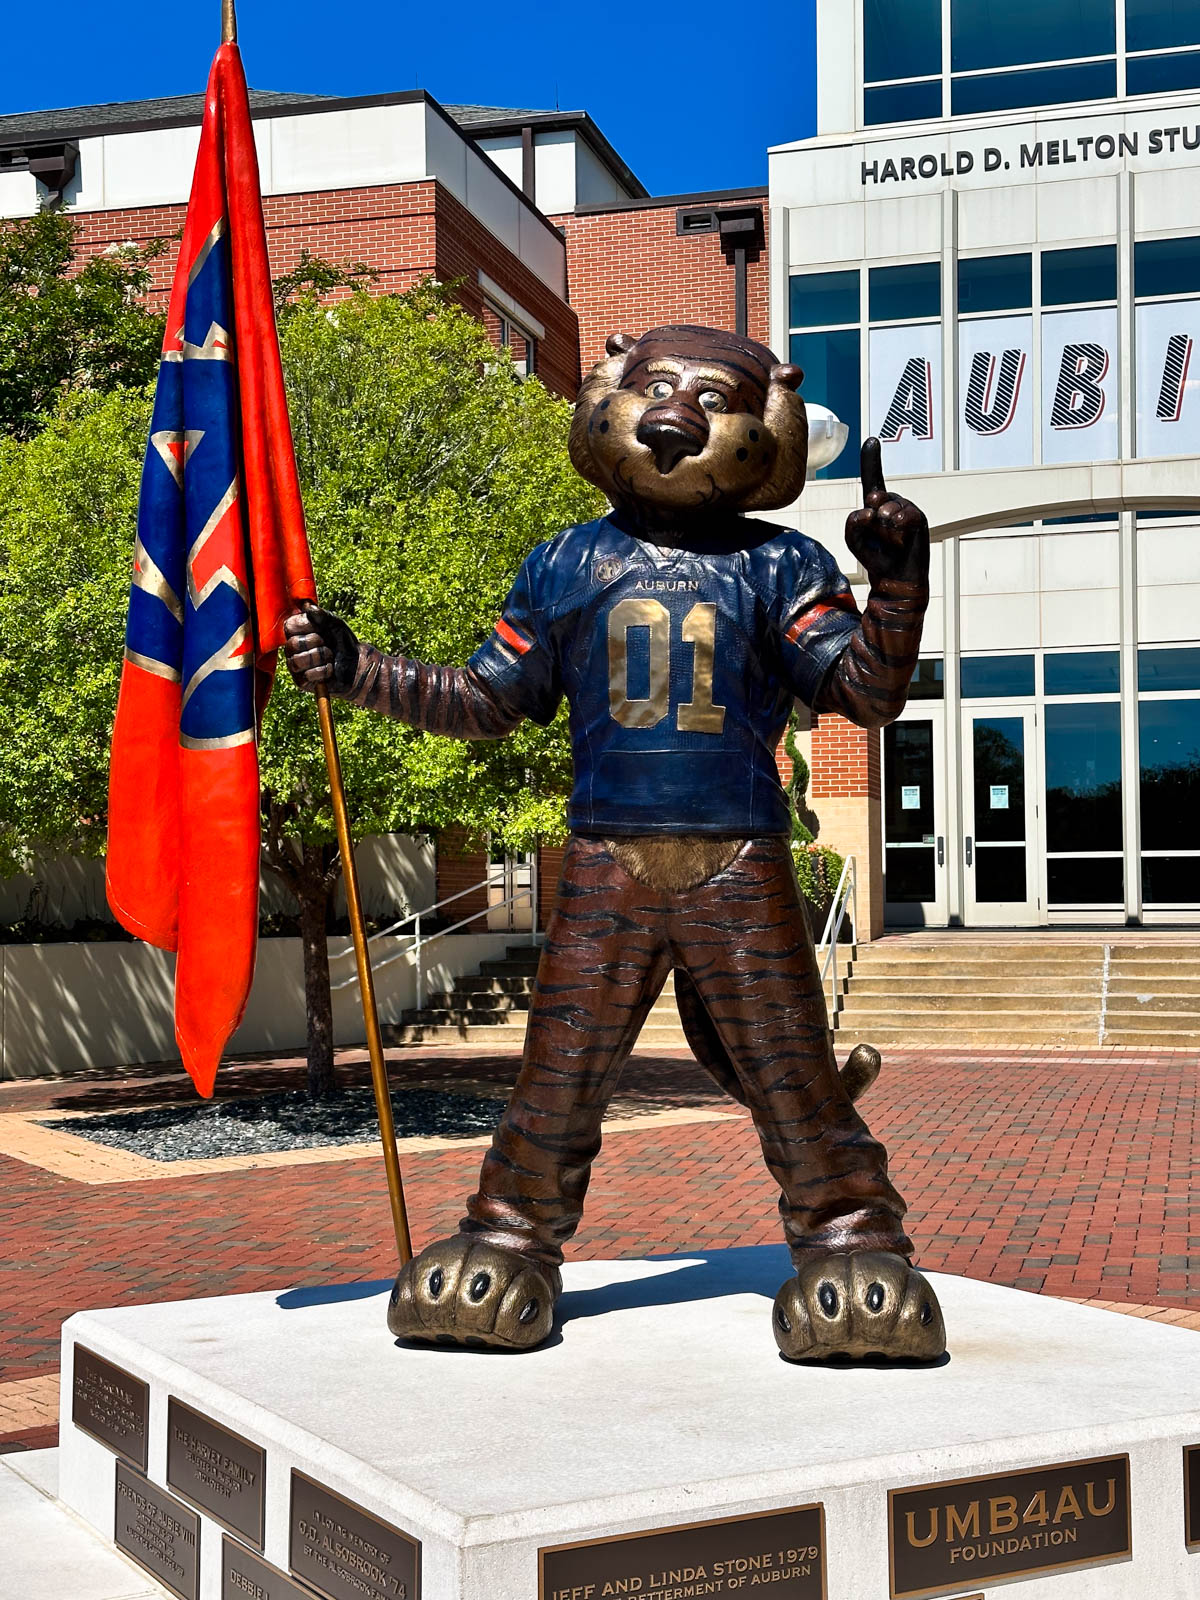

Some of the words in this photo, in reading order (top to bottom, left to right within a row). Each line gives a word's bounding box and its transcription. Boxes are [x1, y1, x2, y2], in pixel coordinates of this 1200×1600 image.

[861, 151, 974, 185] HAROLD
[984, 147, 1010, 171] D.
[1020, 132, 1139, 168] MELTON
[1148, 125, 1200, 154] STU
[635, 580, 699, 592] AUBURN
[608, 598, 726, 734] 01
[174, 1427, 189, 1446] THE
[190, 1438, 222, 1466] HARVEY
[223, 1457, 256, 1487] FAMILY
[117, 1481, 147, 1511] FRIENDS
[147, 1502, 158, 1518] OF
[159, 1511, 181, 1538] AUBIE
[182, 1527, 196, 1549] VIII
[904, 1478, 1117, 1548] UMB4AU
[313, 1550, 328, 1569] THE
[321, 1516, 347, 1540] LOVING
[348, 1532, 379, 1558] MEMORY
[379, 1551, 392, 1566] OF
[321, 1535, 387, 1588] ALSOBROOK
[949, 1527, 1078, 1564] FOUNDATION
[230, 1568, 264, 1600] DEBBIE
[601, 1576, 643, 1597] AND
[649, 1566, 708, 1589] LINDA
[713, 1552, 773, 1577] STONE
[778, 1546, 819, 1566] 1979
[727, 1576, 747, 1590] OF
[750, 1564, 811, 1586] AUBURN
